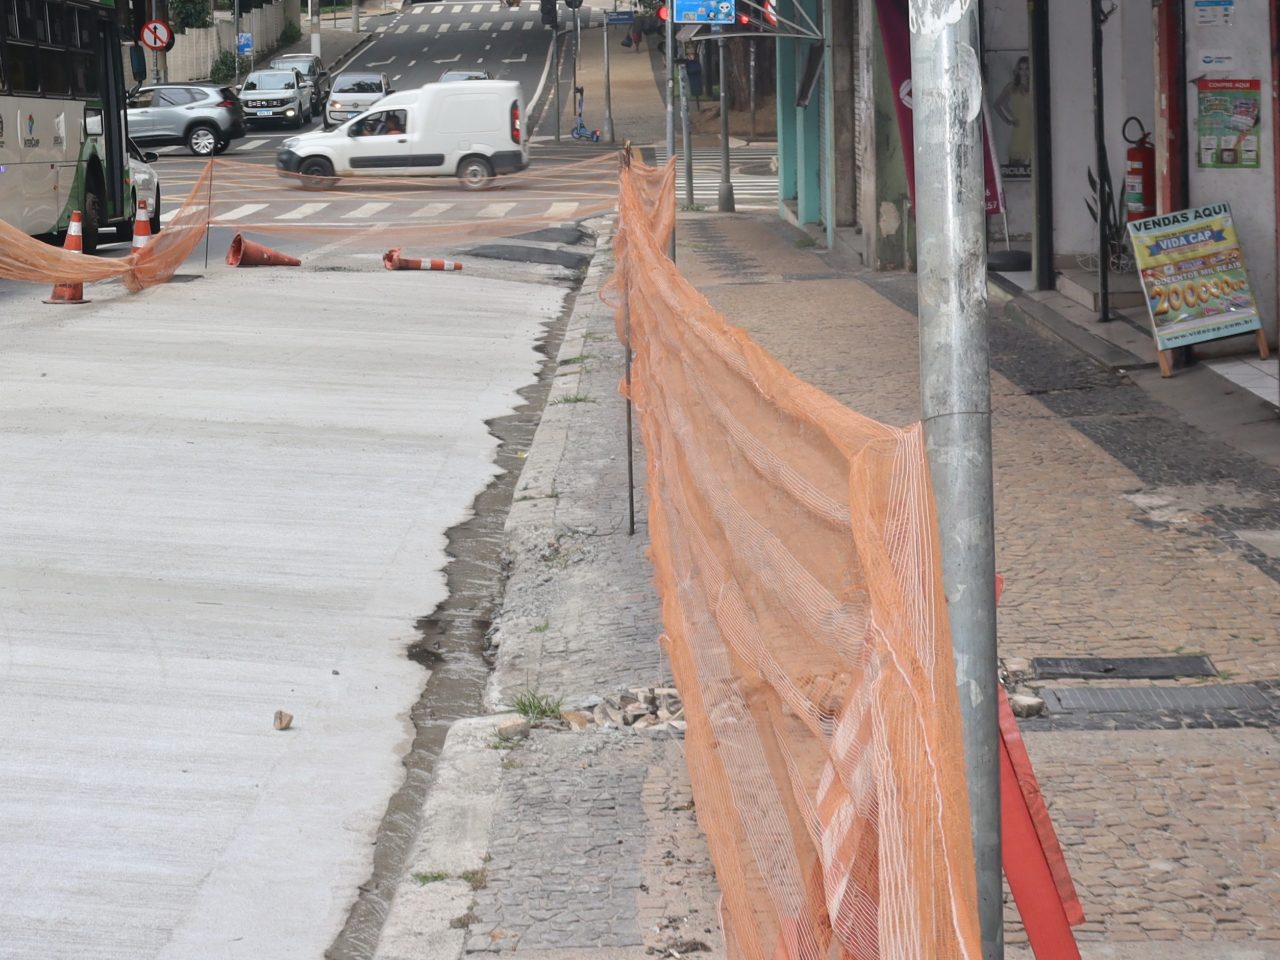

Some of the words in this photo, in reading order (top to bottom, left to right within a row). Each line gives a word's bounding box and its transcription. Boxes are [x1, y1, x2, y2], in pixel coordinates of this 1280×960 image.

[1133, 212, 1190, 232] VENDAS
[1194, 203, 1228, 220] AQUI
[1159, 239, 1187, 250] VIDA
[1189, 231, 1212, 243] CAP
